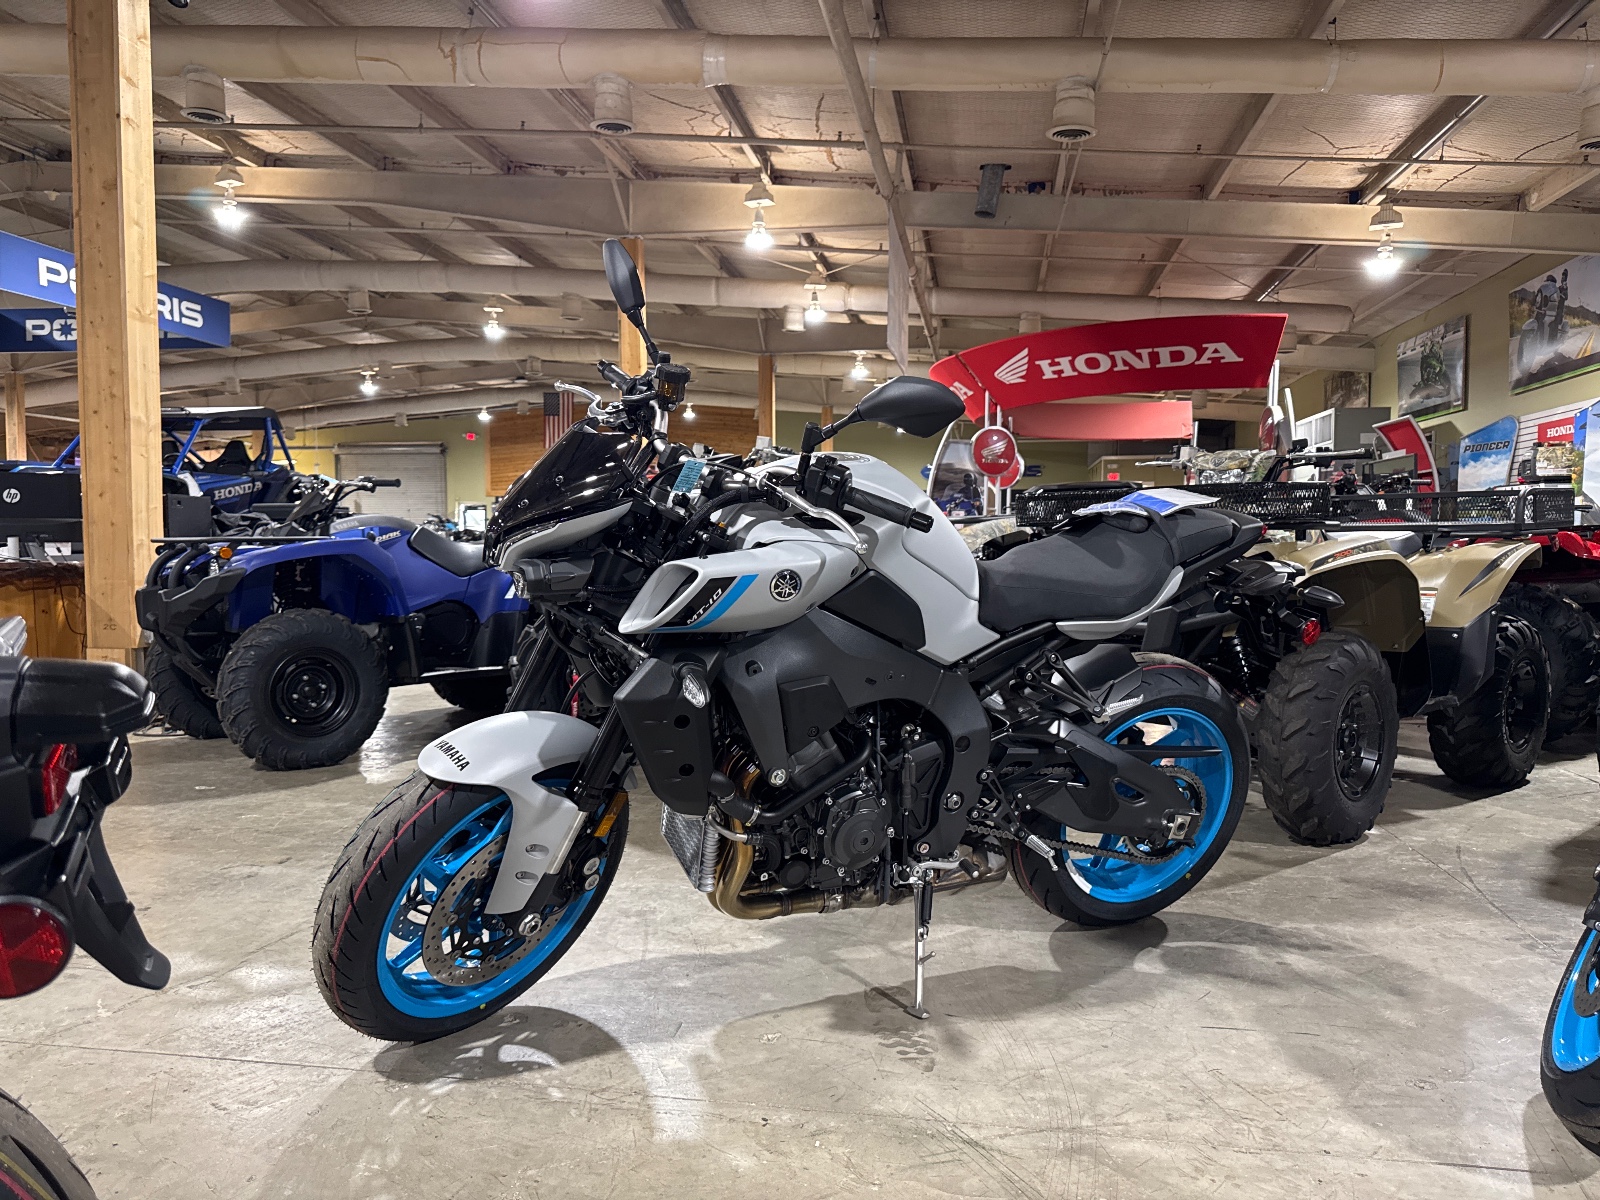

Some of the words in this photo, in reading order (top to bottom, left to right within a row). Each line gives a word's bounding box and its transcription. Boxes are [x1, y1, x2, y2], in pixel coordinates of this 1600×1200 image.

[1035, 342, 1244, 380] HONDA
[1547, 425, 1575, 438] HOND
[1463, 440, 1511, 454] PIONEER
[5, 488, 19, 503] hp
[213, 481, 263, 501] HONDA
[686, 587, 722, 625] MT-10
[433, 739, 471, 772] YAMAHA
